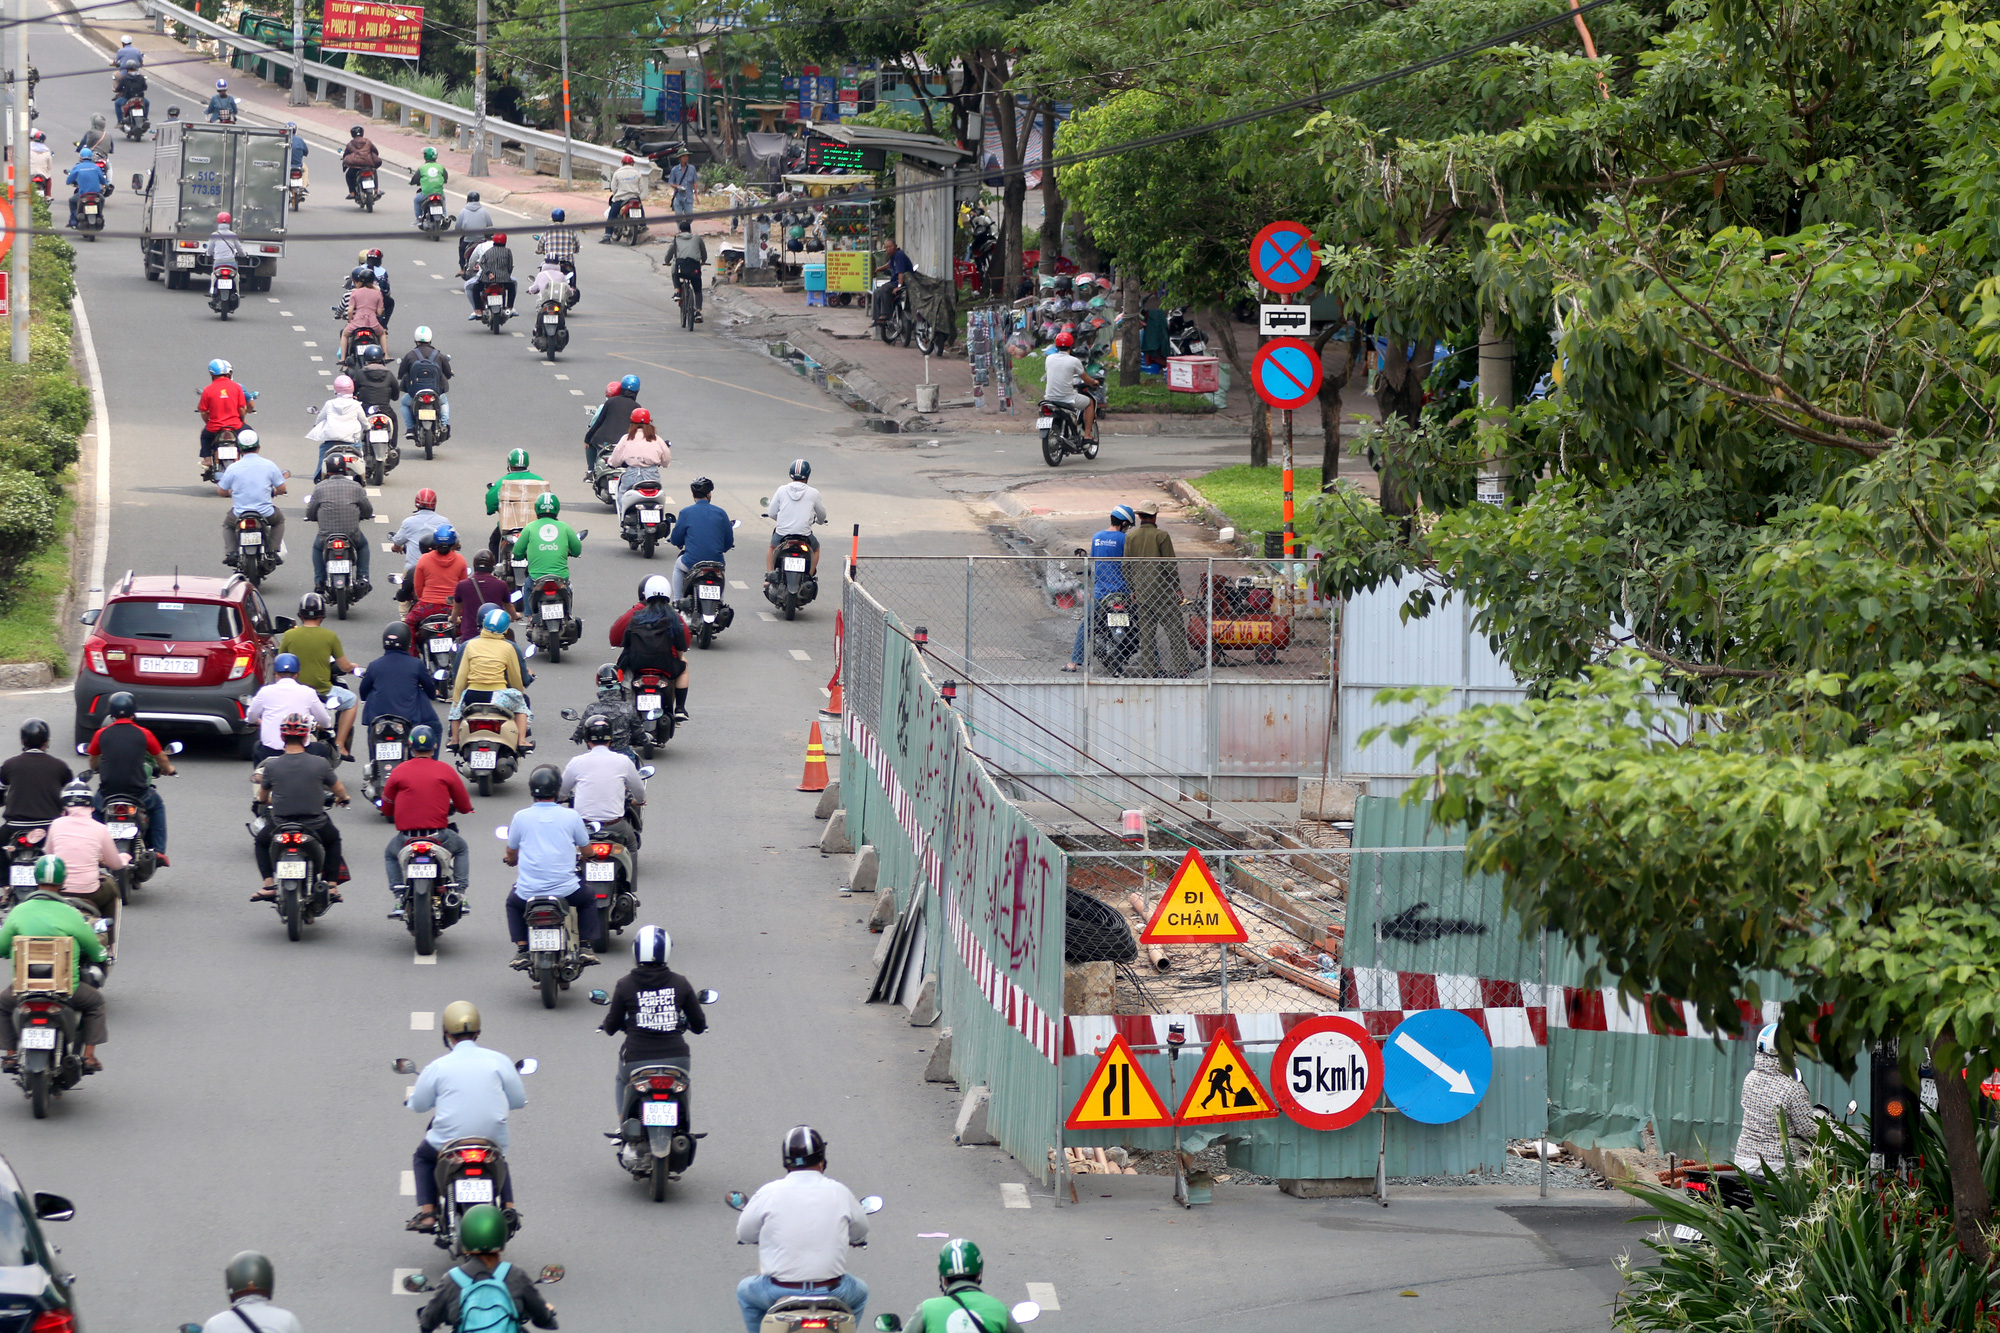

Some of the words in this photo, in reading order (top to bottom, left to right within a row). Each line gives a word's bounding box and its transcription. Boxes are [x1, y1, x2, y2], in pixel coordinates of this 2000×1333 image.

[198, 172, 216, 182] 51C
[192, 184, 221, 195] 773.65
[539, 543, 559, 551] Grab
[143, 659, 195, 671] 51H-217.82
[587, 871, 613, 880] 385.59
[1184, 891, 1204, 904] ĐI
[1167, 910, 1219, 929] CHẬM
[639, 995, 676, 1006] PERFECT
[646, 1114, 676, 1125] 690.78
